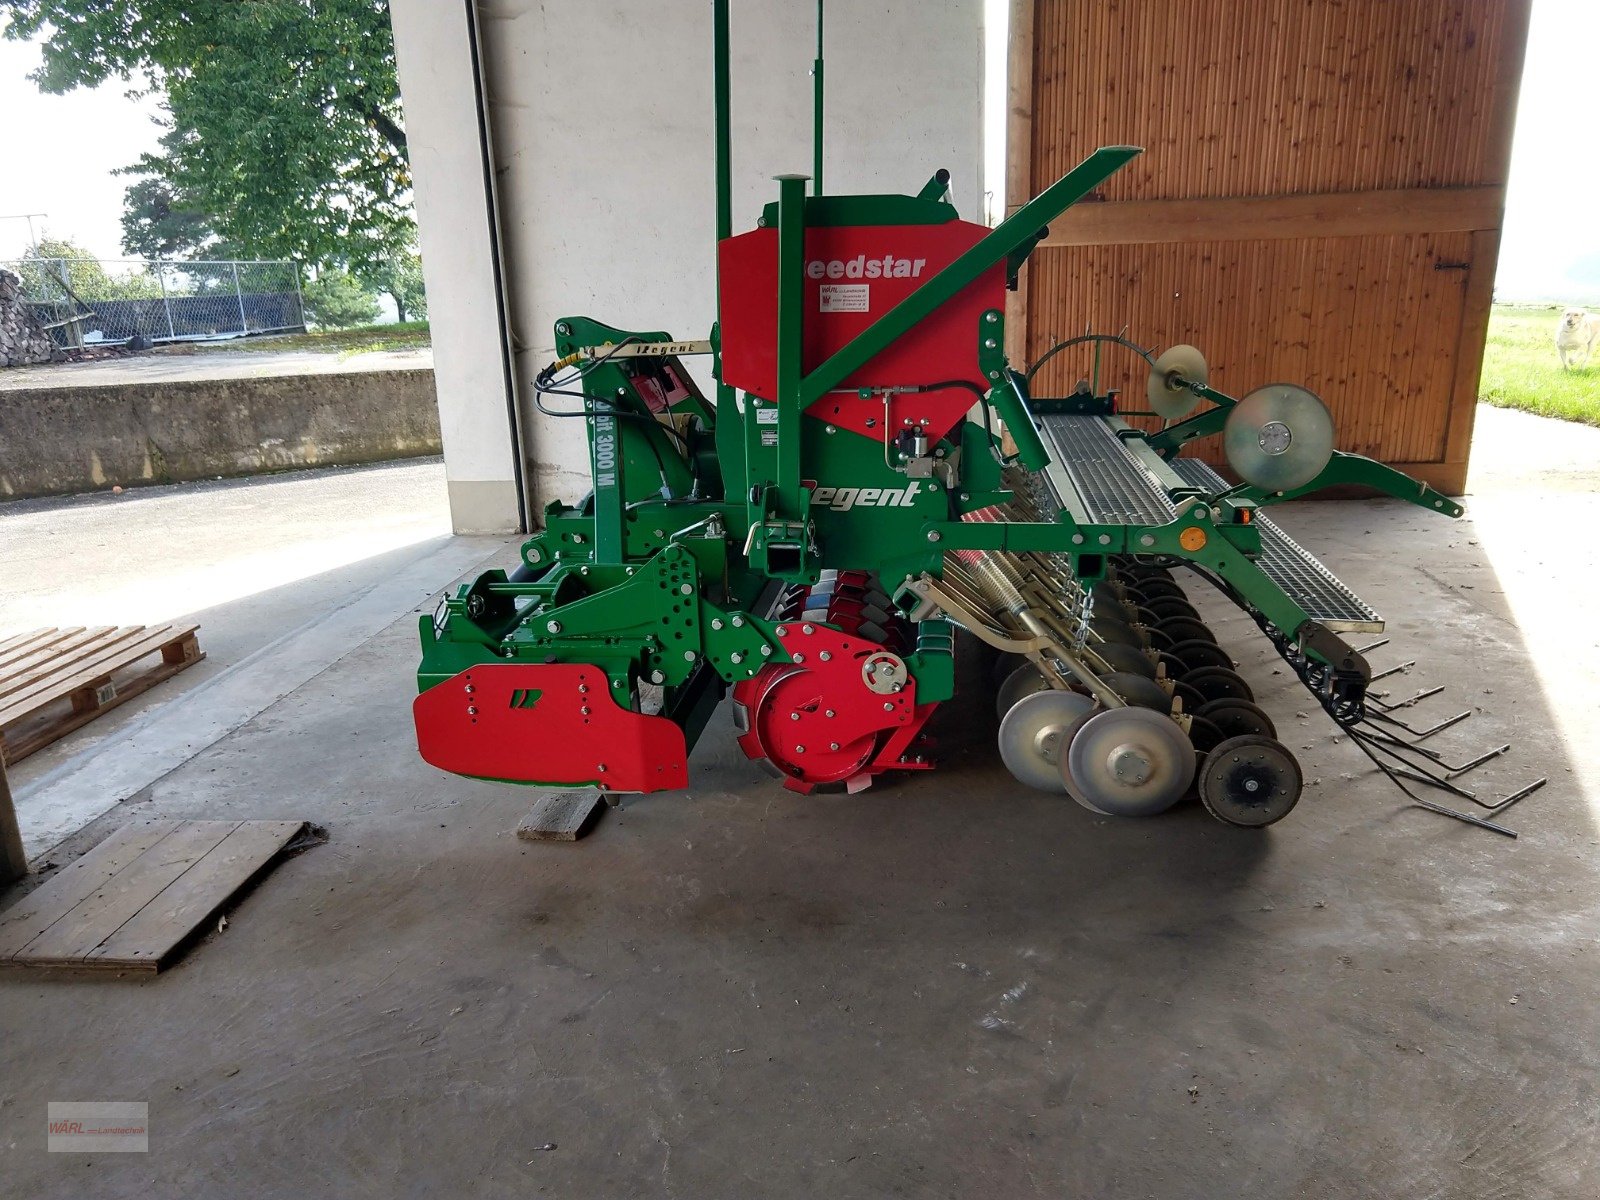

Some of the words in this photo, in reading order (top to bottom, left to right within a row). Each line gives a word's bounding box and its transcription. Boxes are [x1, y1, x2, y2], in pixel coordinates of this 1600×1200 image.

[804, 255, 926, 279] eedstar
[636, 343, 694, 356] Regent
[597, 434, 614, 470] 3000
[597, 472, 615, 487] M
